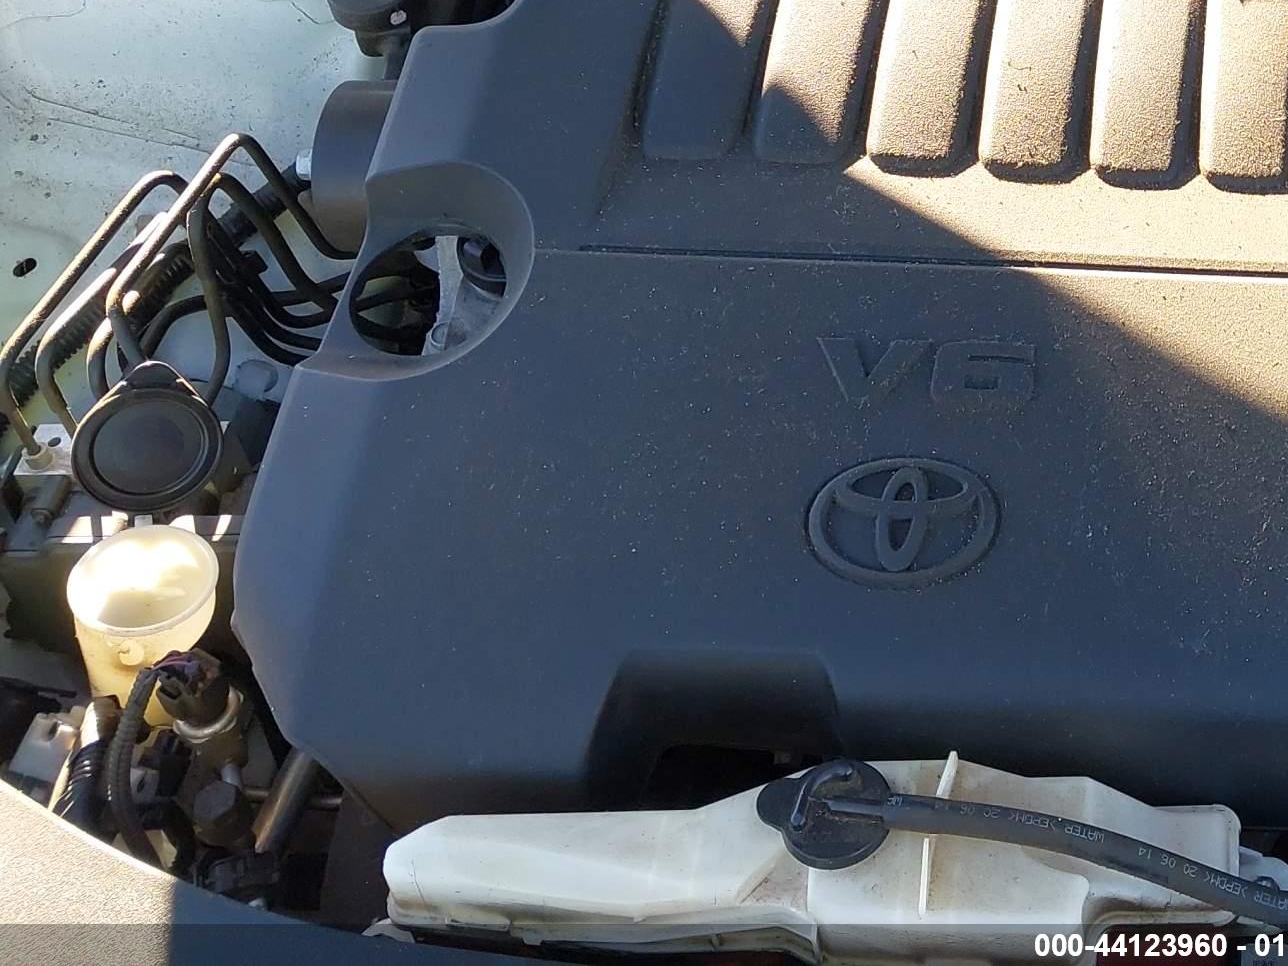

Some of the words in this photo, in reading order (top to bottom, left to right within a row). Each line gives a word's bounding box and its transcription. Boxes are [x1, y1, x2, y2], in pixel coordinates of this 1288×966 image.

[816, 336, 1036, 405] V6
[983, 808, 1001, 819] 20
[1063, 824, 1105, 843] WATER
[1138, 846, 1152, 859] 14
[1183, 863, 1200, 878] 20
